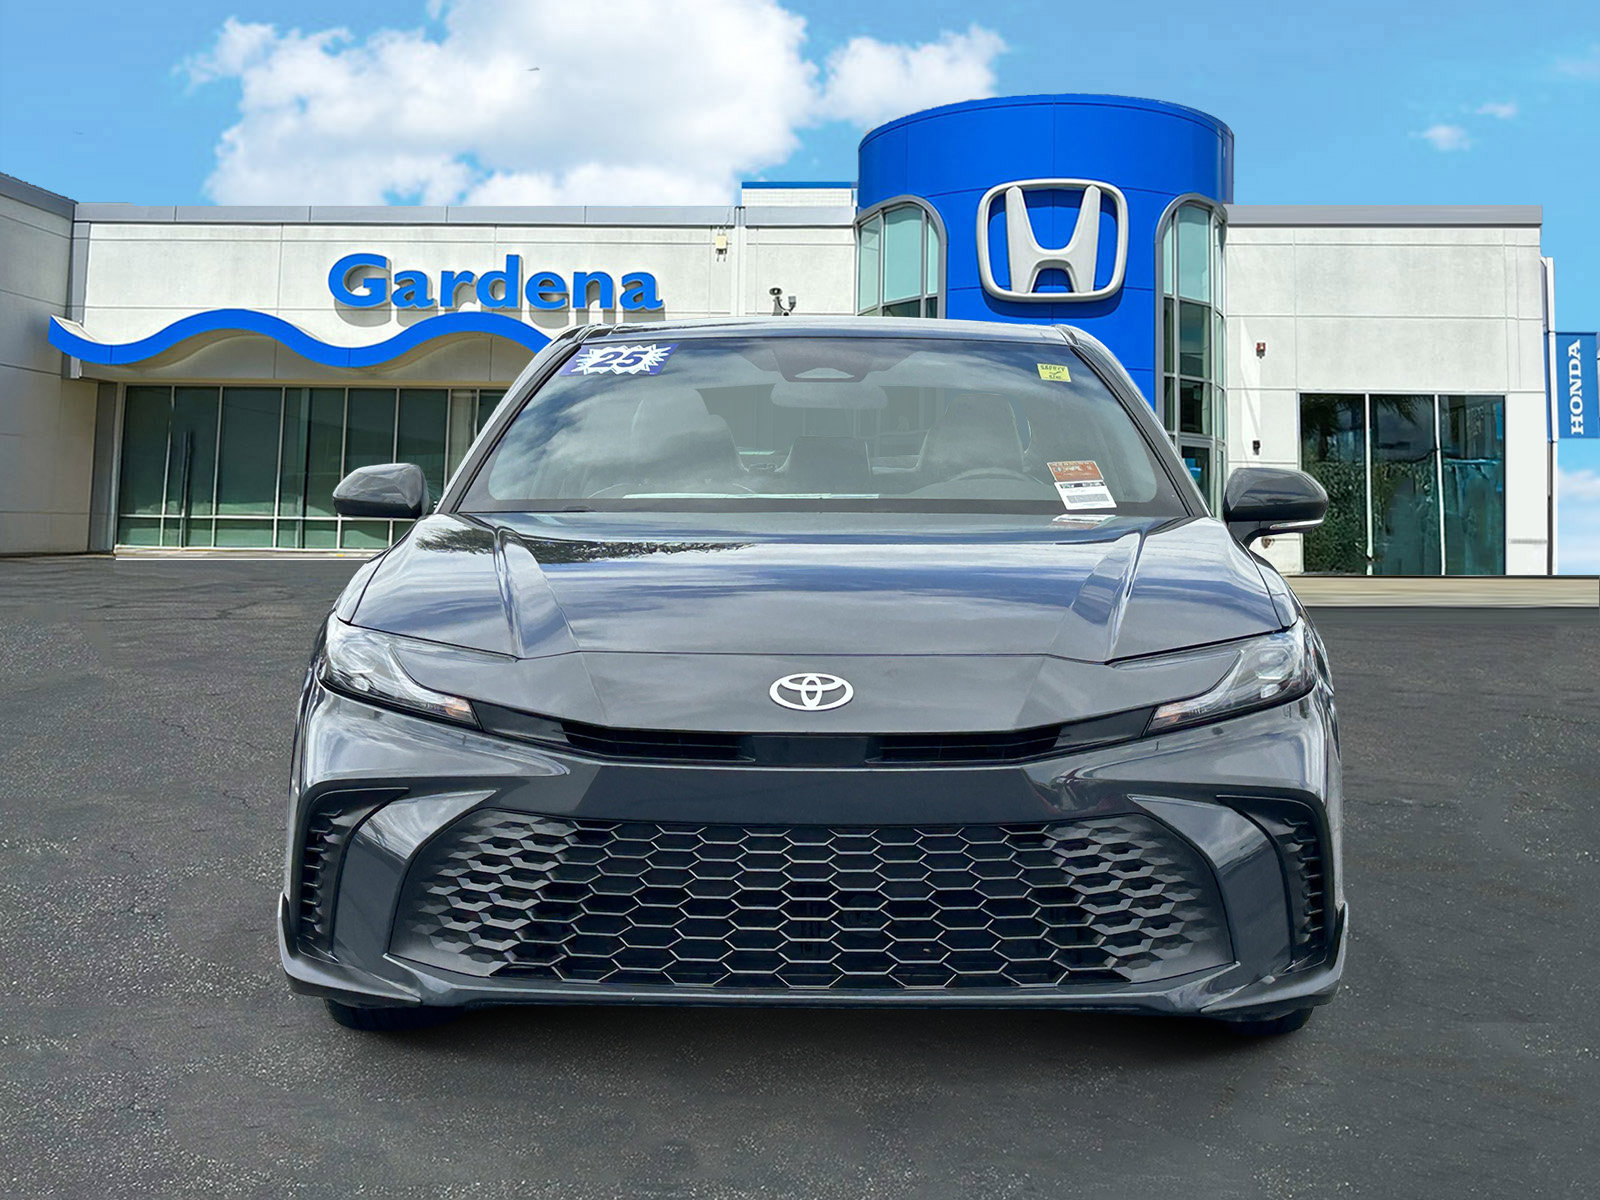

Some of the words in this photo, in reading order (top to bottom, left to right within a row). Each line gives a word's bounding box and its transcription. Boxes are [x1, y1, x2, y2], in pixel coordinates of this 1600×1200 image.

[328, 252, 663, 310] Gardena
[589, 351, 649, 368] 25
[1568, 339, 1584, 435] HONDA
